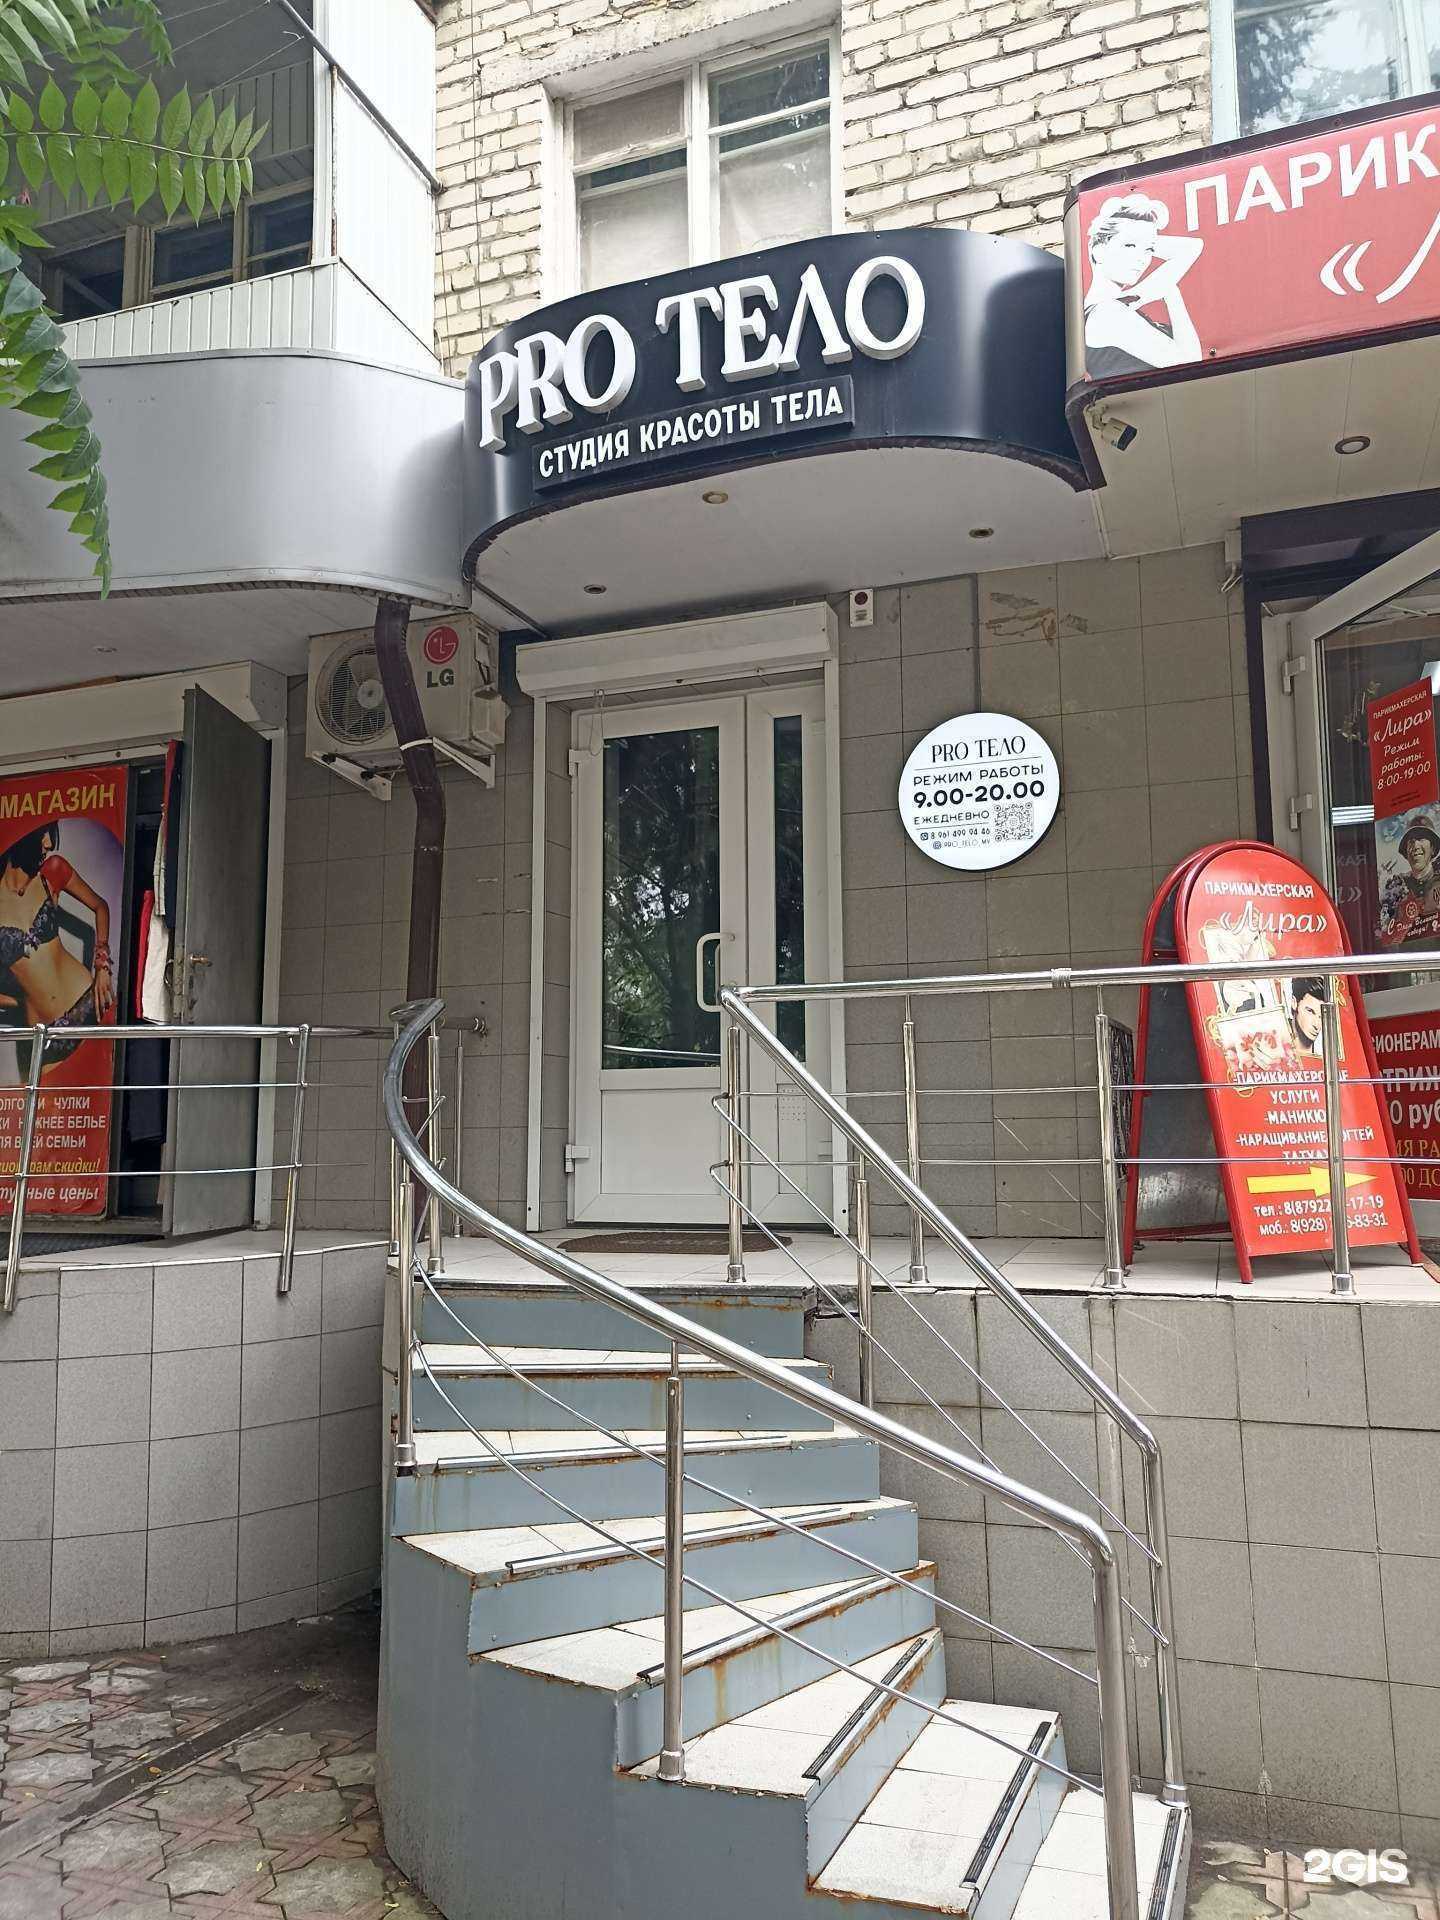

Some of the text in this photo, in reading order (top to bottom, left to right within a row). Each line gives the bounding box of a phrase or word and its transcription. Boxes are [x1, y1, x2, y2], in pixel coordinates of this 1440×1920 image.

[1184, 124, 1440, 232] ПАРИК
[478, 313, 636, 452] PRO
[539, 385, 843, 478] СТУДИЯ КРАСОТЫ ТЕЛА
[426, 668, 455, 688] LG
[932, 742, 969, 763] PRO
[1383, 737, 1420, 757] Режим
[913, 764, 1044, 787] РЕЖИМ РАБОТЫ
[0, 783, 116, 819] МАГАЗИН
[913, 780, 1045, 808] 9.00-20.00
[914, 810, 990, 825] ЕЖЕДНЕВНО
[1204, 881, 1314, 899] ПАРИКМАХЕРСКАЯ
[1218, 900, 1328, 940] «Лира»
[1371, 1030, 1440, 1053] ИОНЕРАМ
[1379, 1066, 1440, 1093] ТРИЖ
[54, 1096, 90, 1110] ЧУЛКИ
[1269, 1089, 1320, 1104] УСЛУГИ
[67, 1115, 106, 1129] БЕЛЬЕ
[1263, 1109, 1327, 1125] -МАНИКЮ
[46, 1135, 86, 1148] СЕМЬИ
[1235, 1129, 1328, 1147] -НАРАЩИВАНИЕ
[54, 1157, 101, 1173] скидки!
[0, 1185, 99, 1203] туные цены
[1283, 1198, 1332, 1216] 8(87922
[1345, 1194, 1385, 1210] -17-19
[1290, 1217, 1329, 1235] 8(928)
